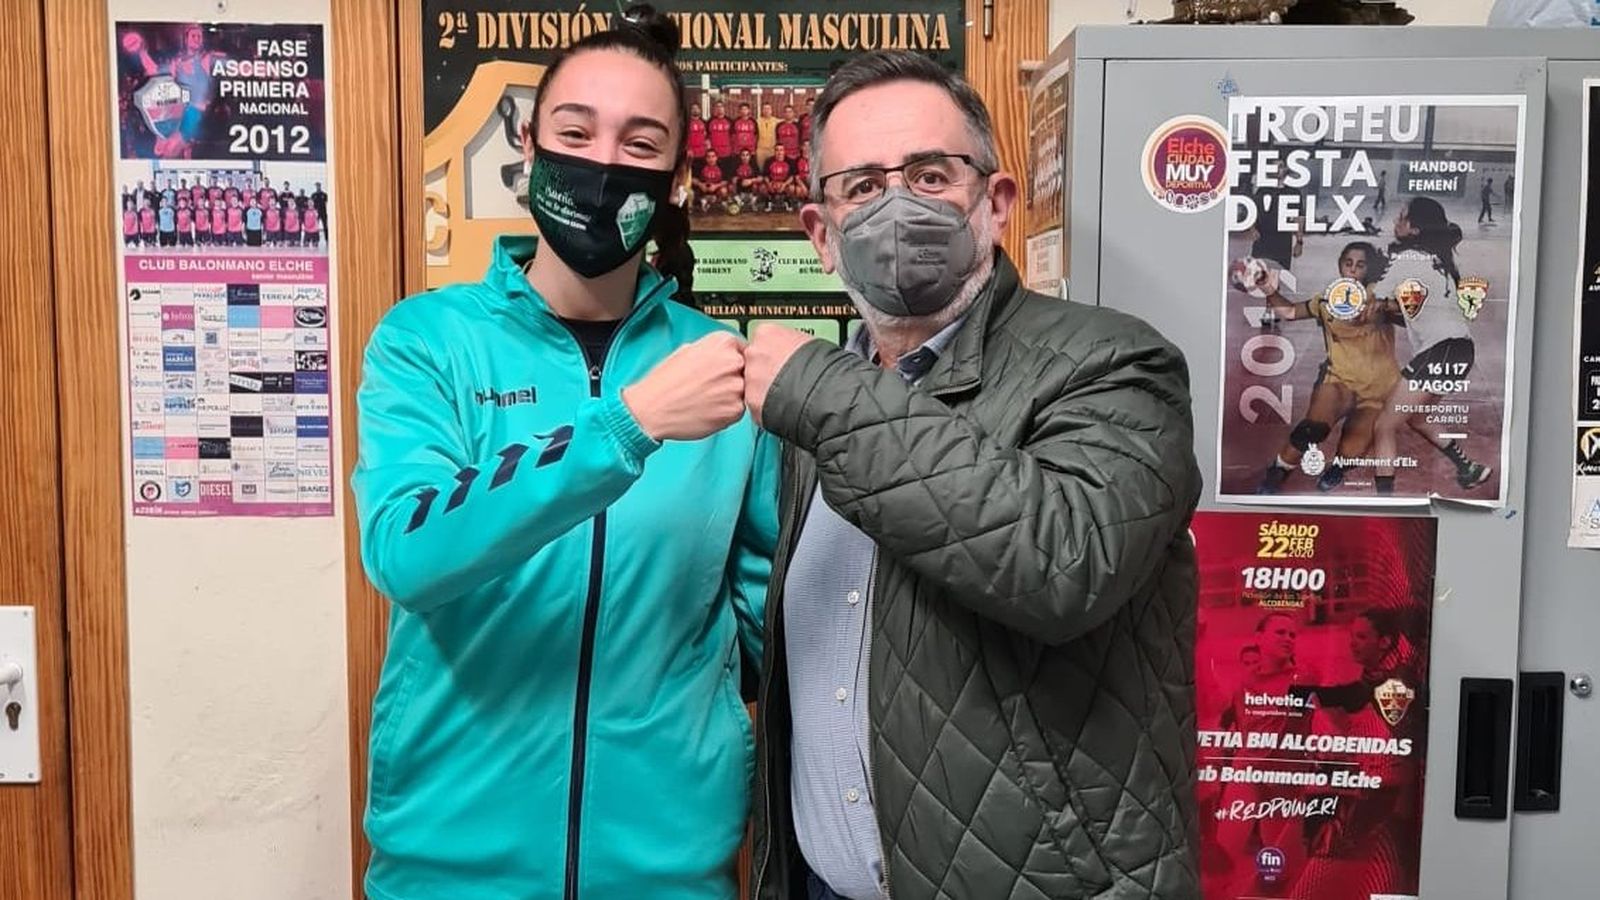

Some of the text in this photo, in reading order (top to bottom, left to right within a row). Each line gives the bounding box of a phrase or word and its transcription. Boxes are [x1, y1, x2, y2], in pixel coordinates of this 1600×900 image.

[778, 13, 950, 50] MASCULINA
[257, 40, 308, 57] FASE
[212, 60, 308, 77] ASCENSO
[695, 60, 789, 72] PARTICIPANTES:
[220, 81, 309, 98] PRIMERA
[239, 103, 308, 115] NACIONAL
[1230, 103, 1418, 143] TROFEU
[229, 125, 311, 154] 2012
[1167, 137, 1216, 155] Elche
[1167, 154, 1215, 165] CIUDAD
[1408, 161, 1475, 173] HANDBOL
[1166, 164, 1214, 181] MUY
[1230, 151, 1378, 188] FESTA
[1408, 176, 1459, 191] FEMENÍ
[1227, 194, 1365, 232] D'ELX
[138, 260, 314, 271] CLUB BALONMANO ELCHE
[749, 305, 811, 315] MUNICIPAL
[1427, 363, 1442, 377] 16
[1453, 363, 1468, 377] 17
[1409, 379, 1471, 393] D'AGOST
[1394, 404, 1470, 414] POLIESPORTIU
[1332, 455, 1419, 469] Ajuntament d'Elx
[199, 483, 232, 497] DIESEL
[1258, 521, 1319, 538] SÁBADO
[1257, 537, 1314, 558] 22 FEB
[1289, 548, 1315, 559] 2020
[1241, 567, 1326, 591] 18H00
[1245, 692, 1304, 707] helvetia
[1246, 732, 1279, 749] BM
[1280, 733, 1413, 756] ALCOBENDAS
[1220, 766, 1328, 786] Balonmano
[1331, 769, 1382, 789] Elche
[1215, 796, 1340, 820] #REDPOWER!
[1261, 852, 1281, 866] fin
